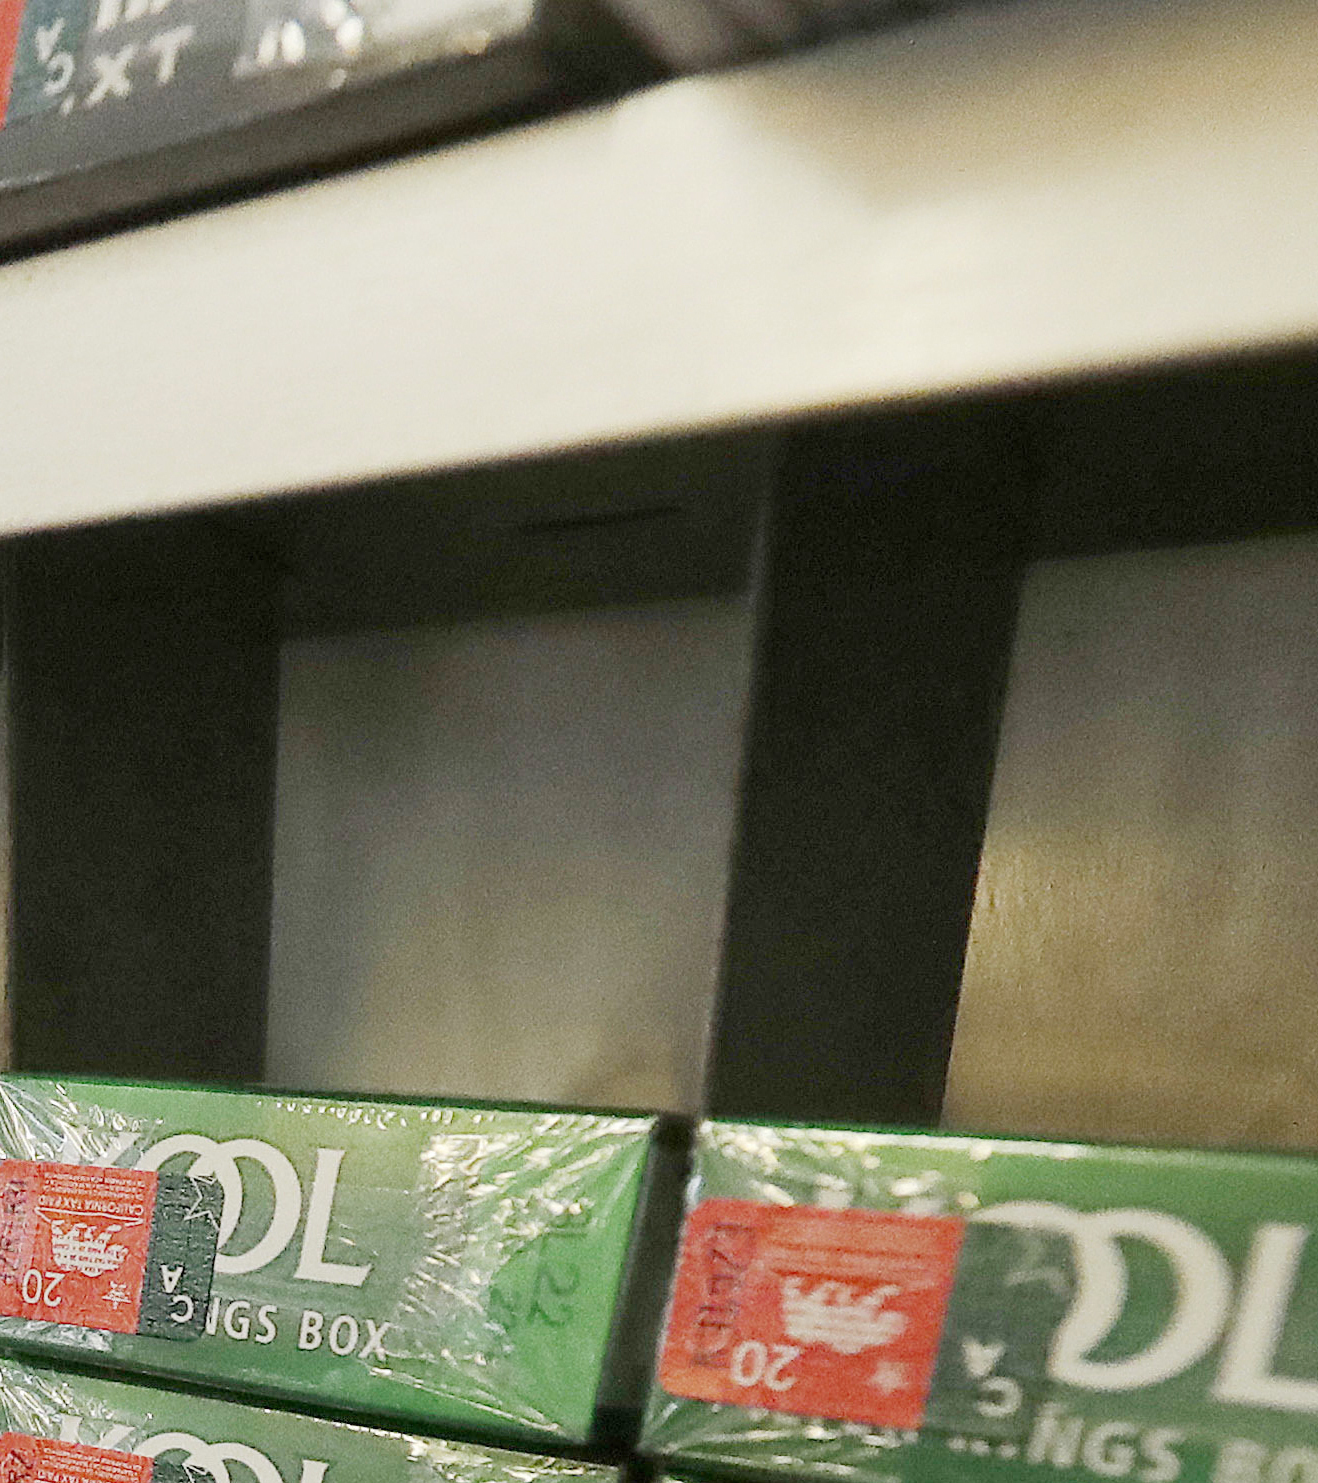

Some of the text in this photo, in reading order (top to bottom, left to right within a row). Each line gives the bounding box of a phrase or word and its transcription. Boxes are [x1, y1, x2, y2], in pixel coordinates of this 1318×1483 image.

[63, 1194, 83, 1210] TAX
[84, 1196, 145, 1216] CALIFORNIA
[21, 1268, 66, 1308] 20
[297, 1309, 392, 1362] BOX
[730, 1339, 802, 1392] 20
